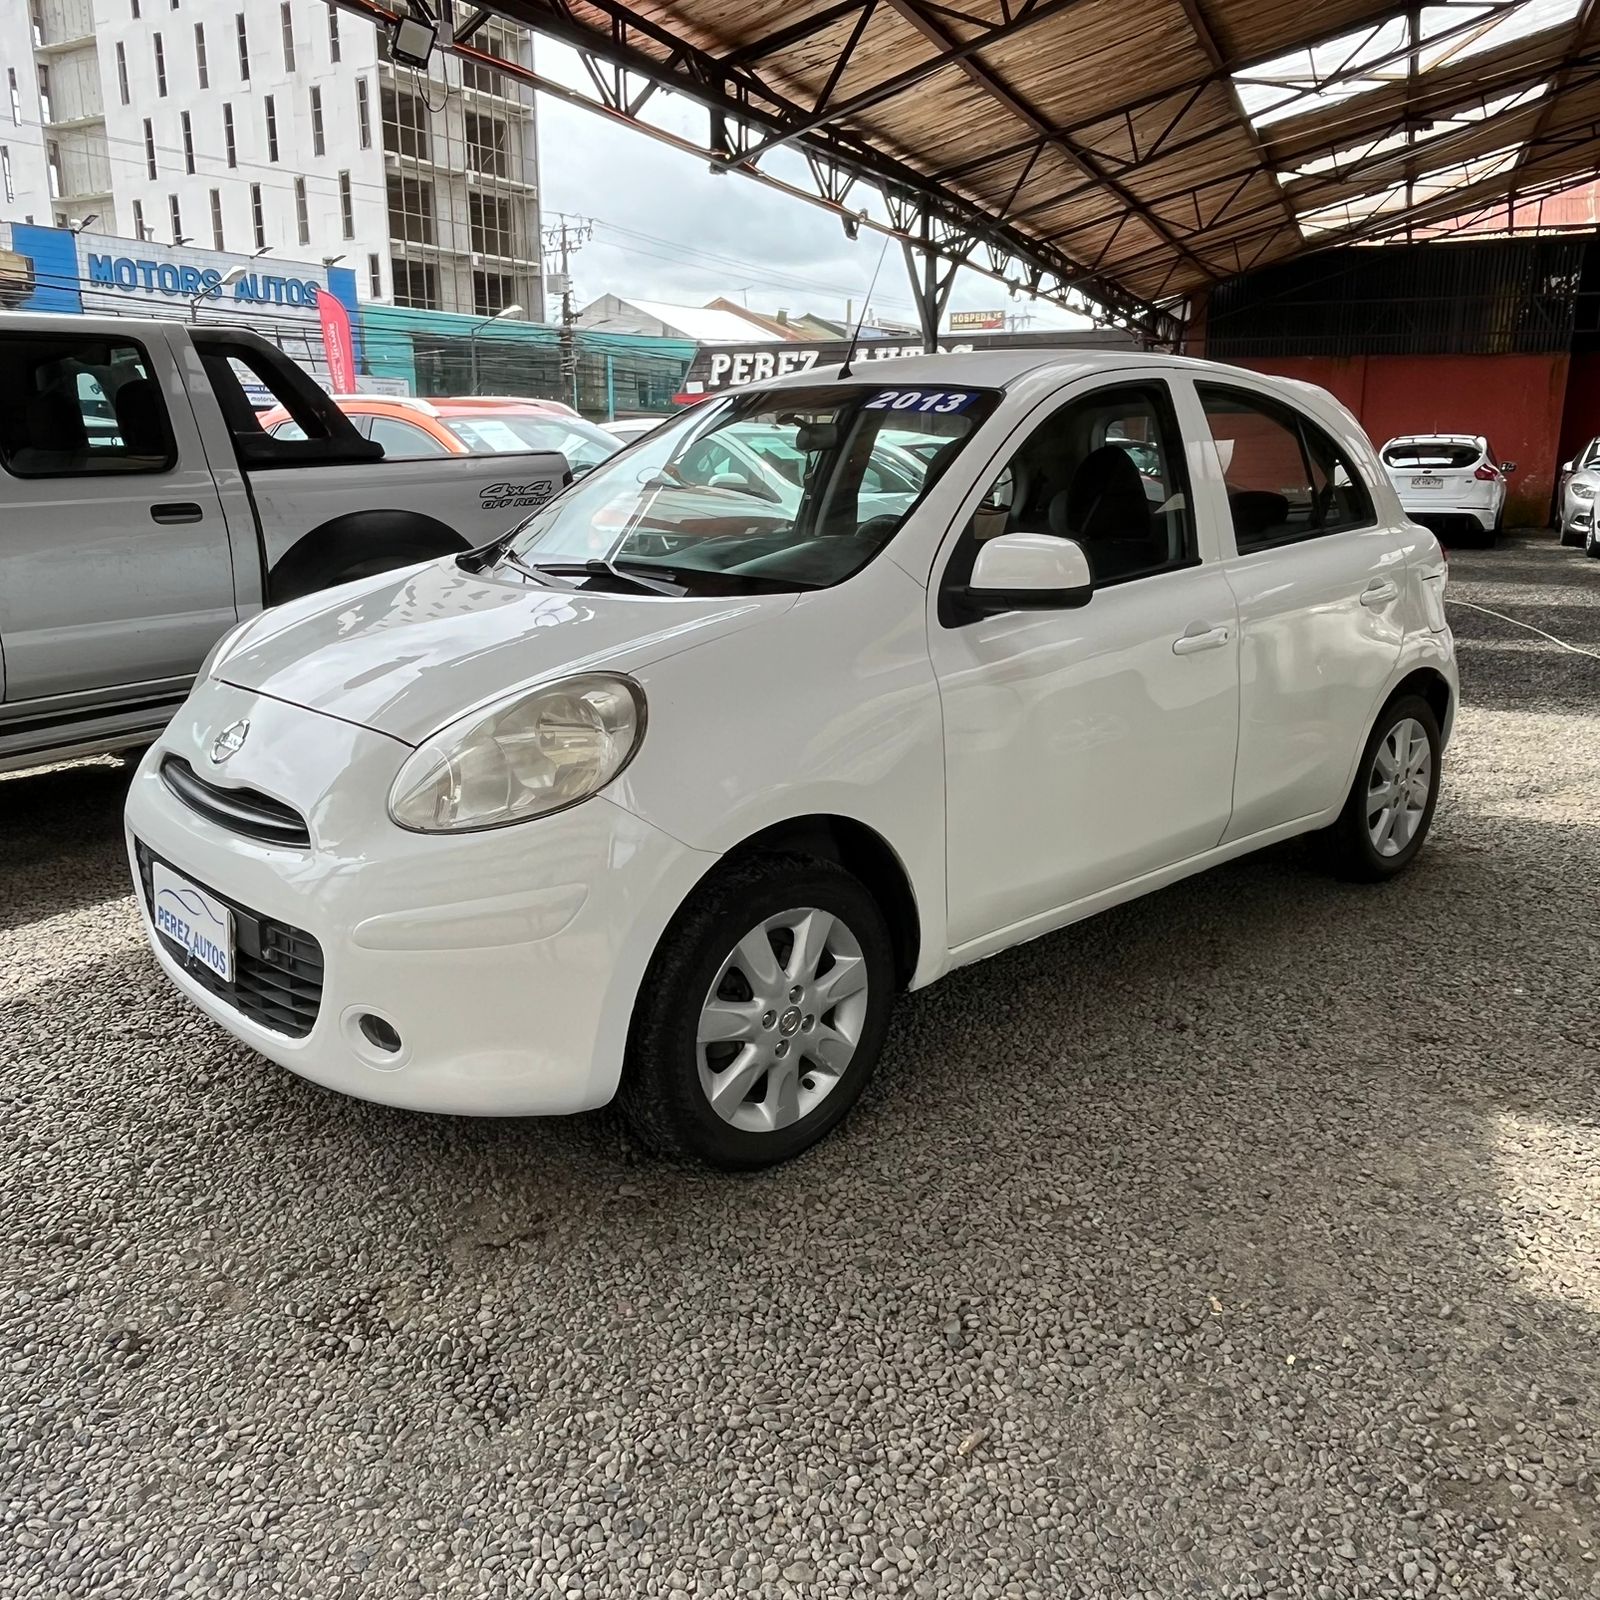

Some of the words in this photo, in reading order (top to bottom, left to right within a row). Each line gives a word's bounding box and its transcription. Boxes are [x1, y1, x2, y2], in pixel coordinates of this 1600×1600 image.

[88, 253, 222, 301] MOTORS
[233, 273, 321, 308] AUTOS
[864, 391, 968, 413] 2013
[479, 480, 552, 499] 4x4
[482, 499, 512, 510] OFF
[513, 496, 553, 507] ROA
[158, 905, 192, 948] PEREZ
[193, 931, 226, 975] AUTOS
